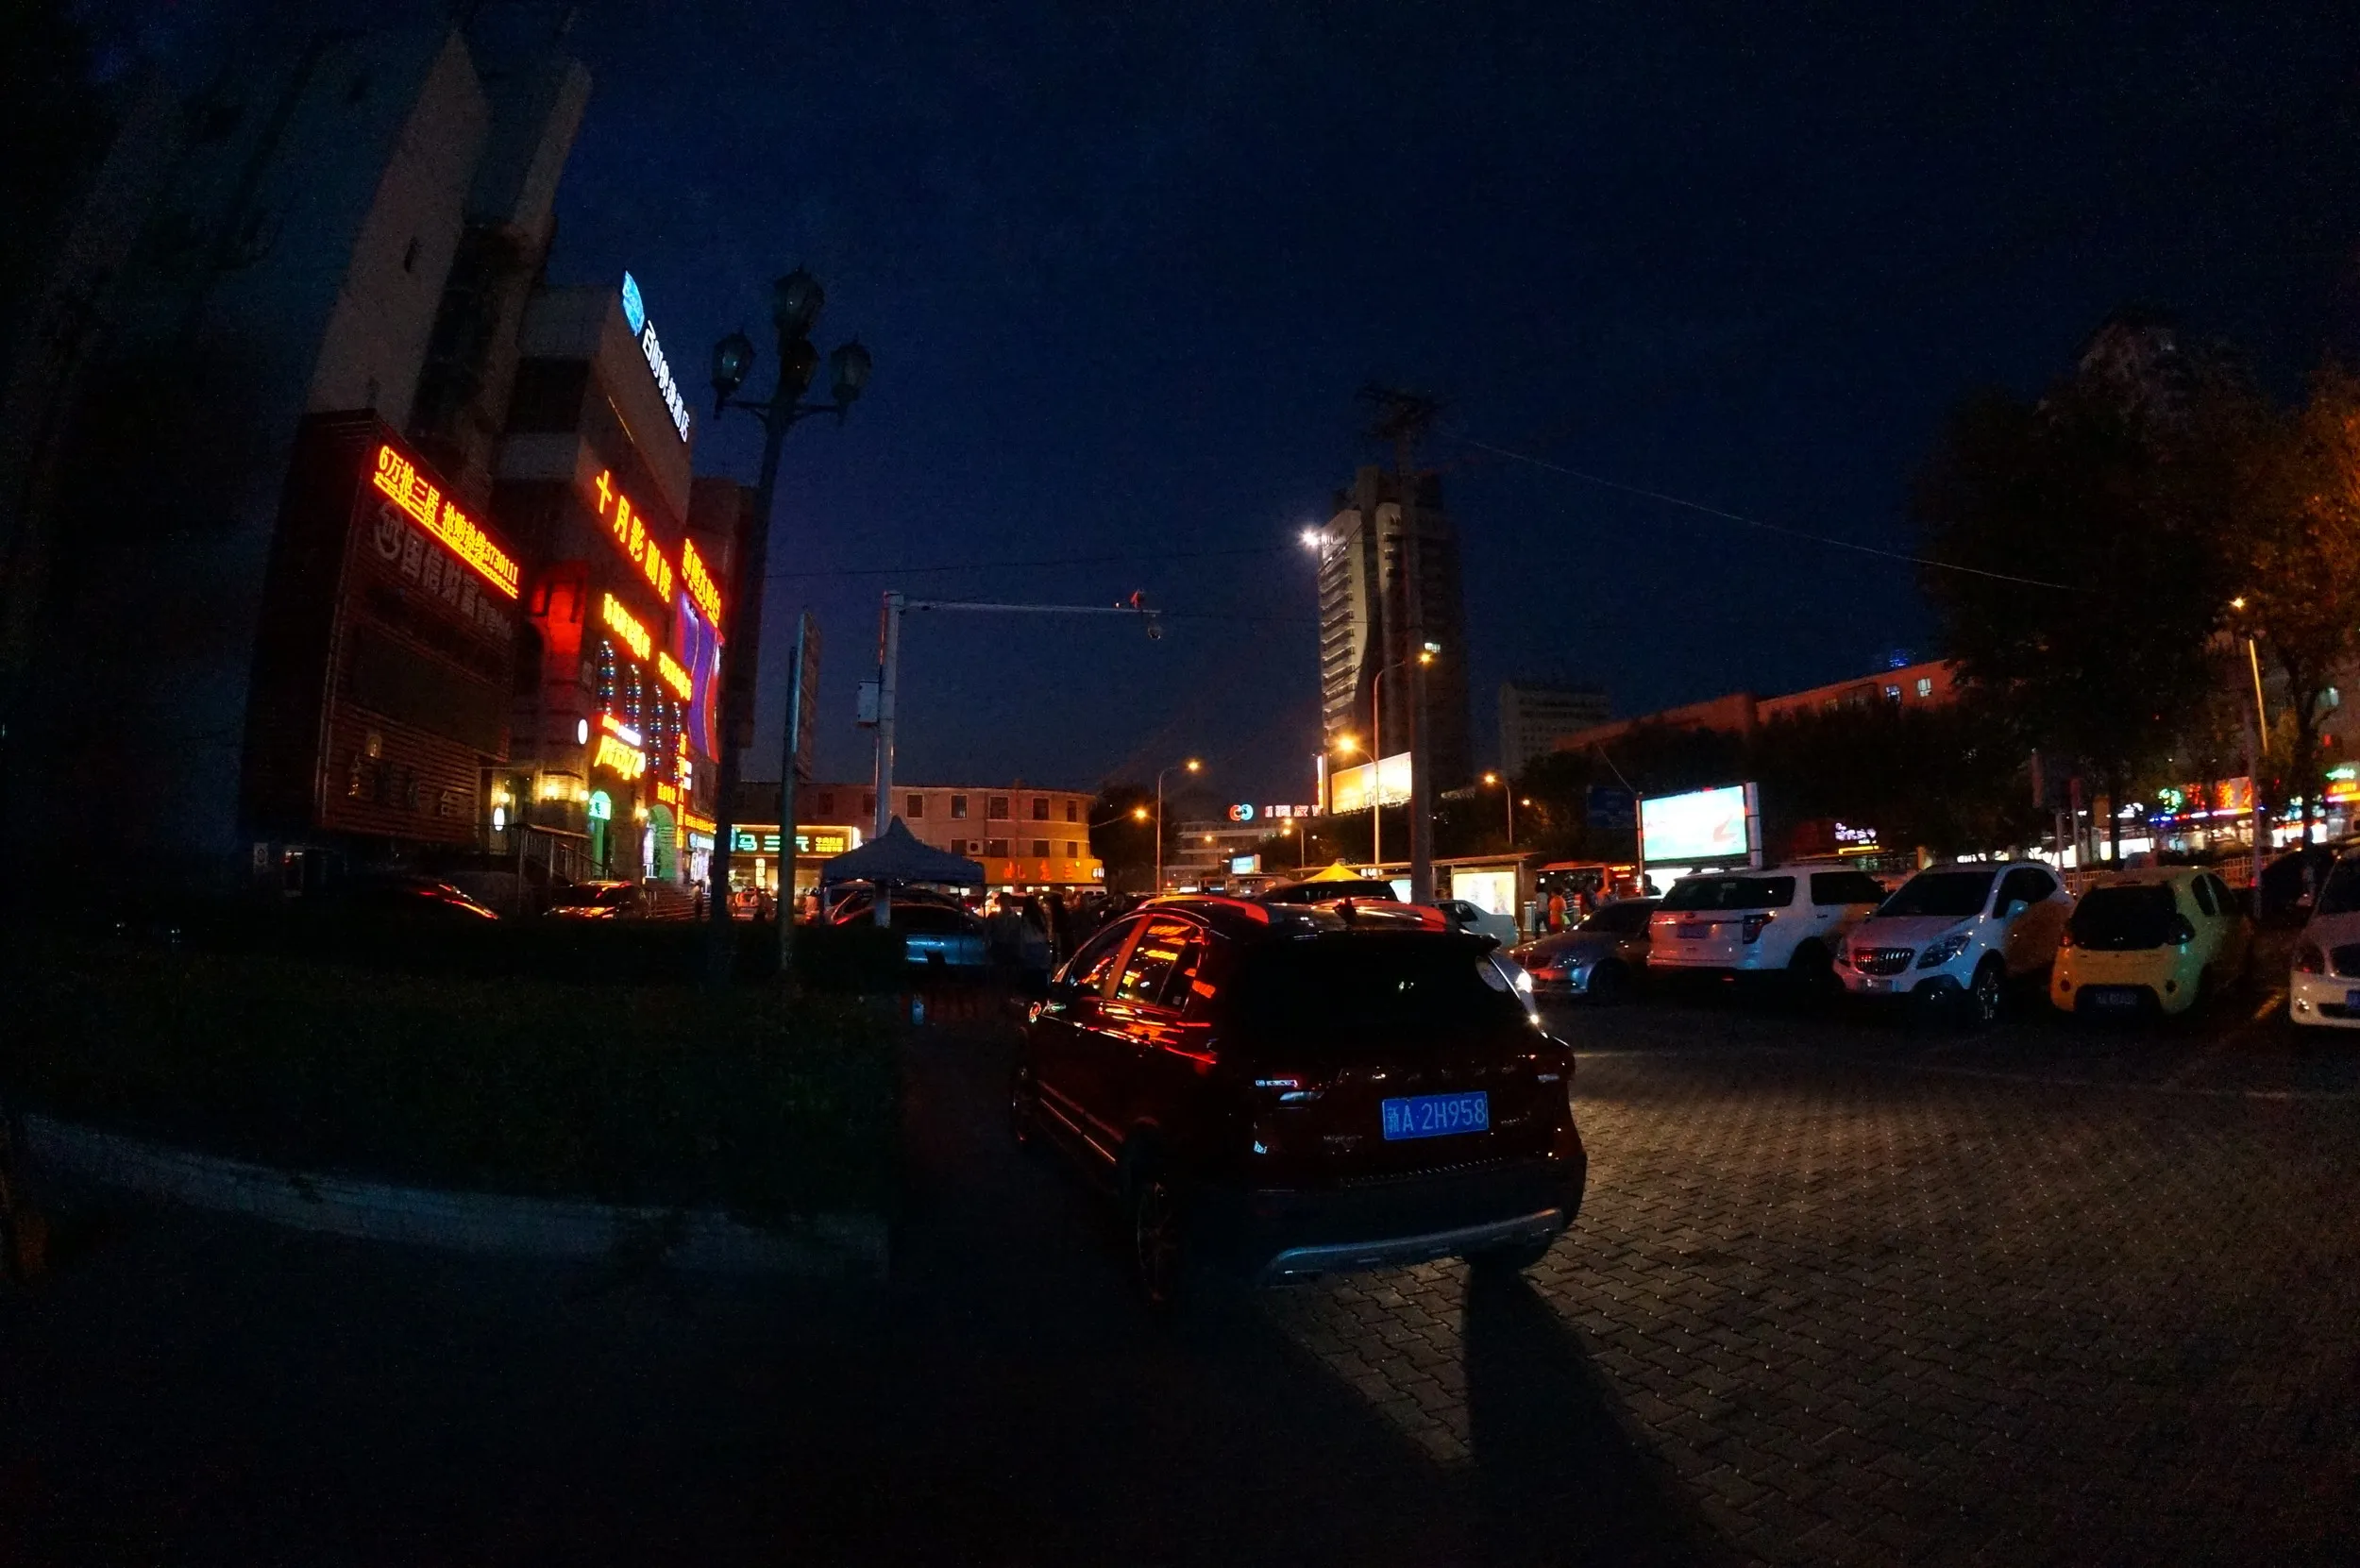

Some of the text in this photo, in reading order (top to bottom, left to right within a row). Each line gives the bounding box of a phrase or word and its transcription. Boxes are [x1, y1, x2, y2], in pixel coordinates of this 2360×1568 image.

[595, 469, 672, 603] 十月影剧院
